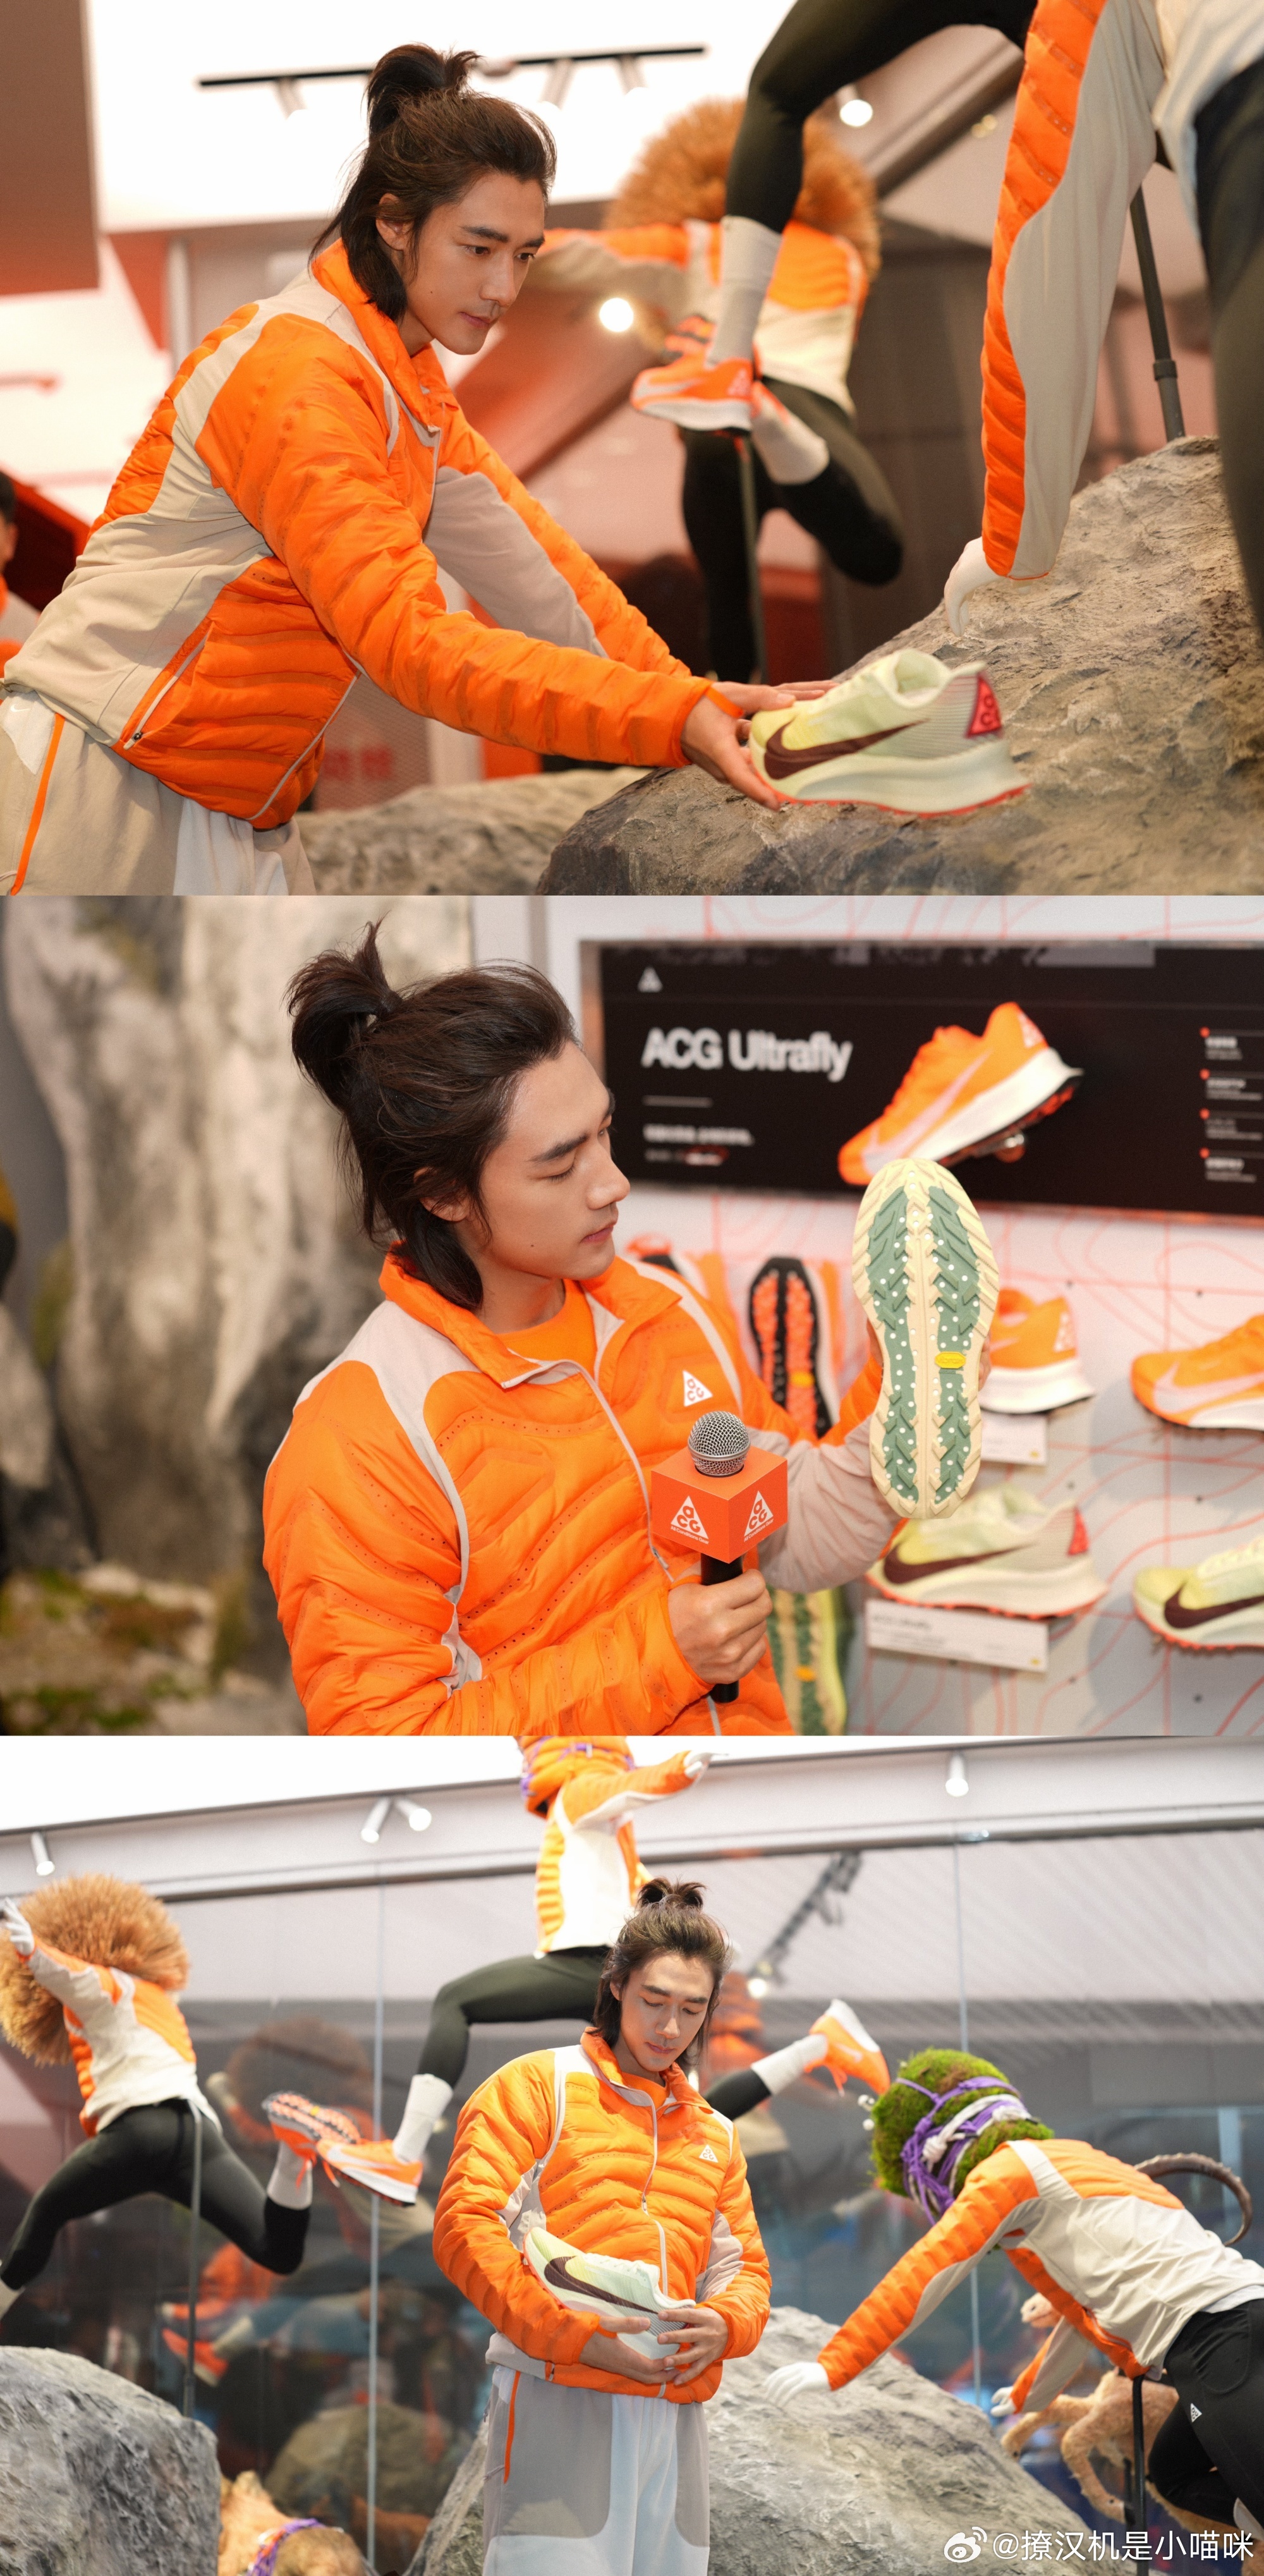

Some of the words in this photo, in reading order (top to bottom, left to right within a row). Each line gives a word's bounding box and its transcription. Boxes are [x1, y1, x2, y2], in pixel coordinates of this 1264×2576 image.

[641, 1026, 724, 1069] ACG
[728, 1028, 853, 1083] Ultrafly
[676, 1528, 700, 1541] Conditions
[698, 1537, 709, 1545] Gear
[748, 1524, 766, 1539] Conditions
[765, 1518, 774, 1527] Gear
